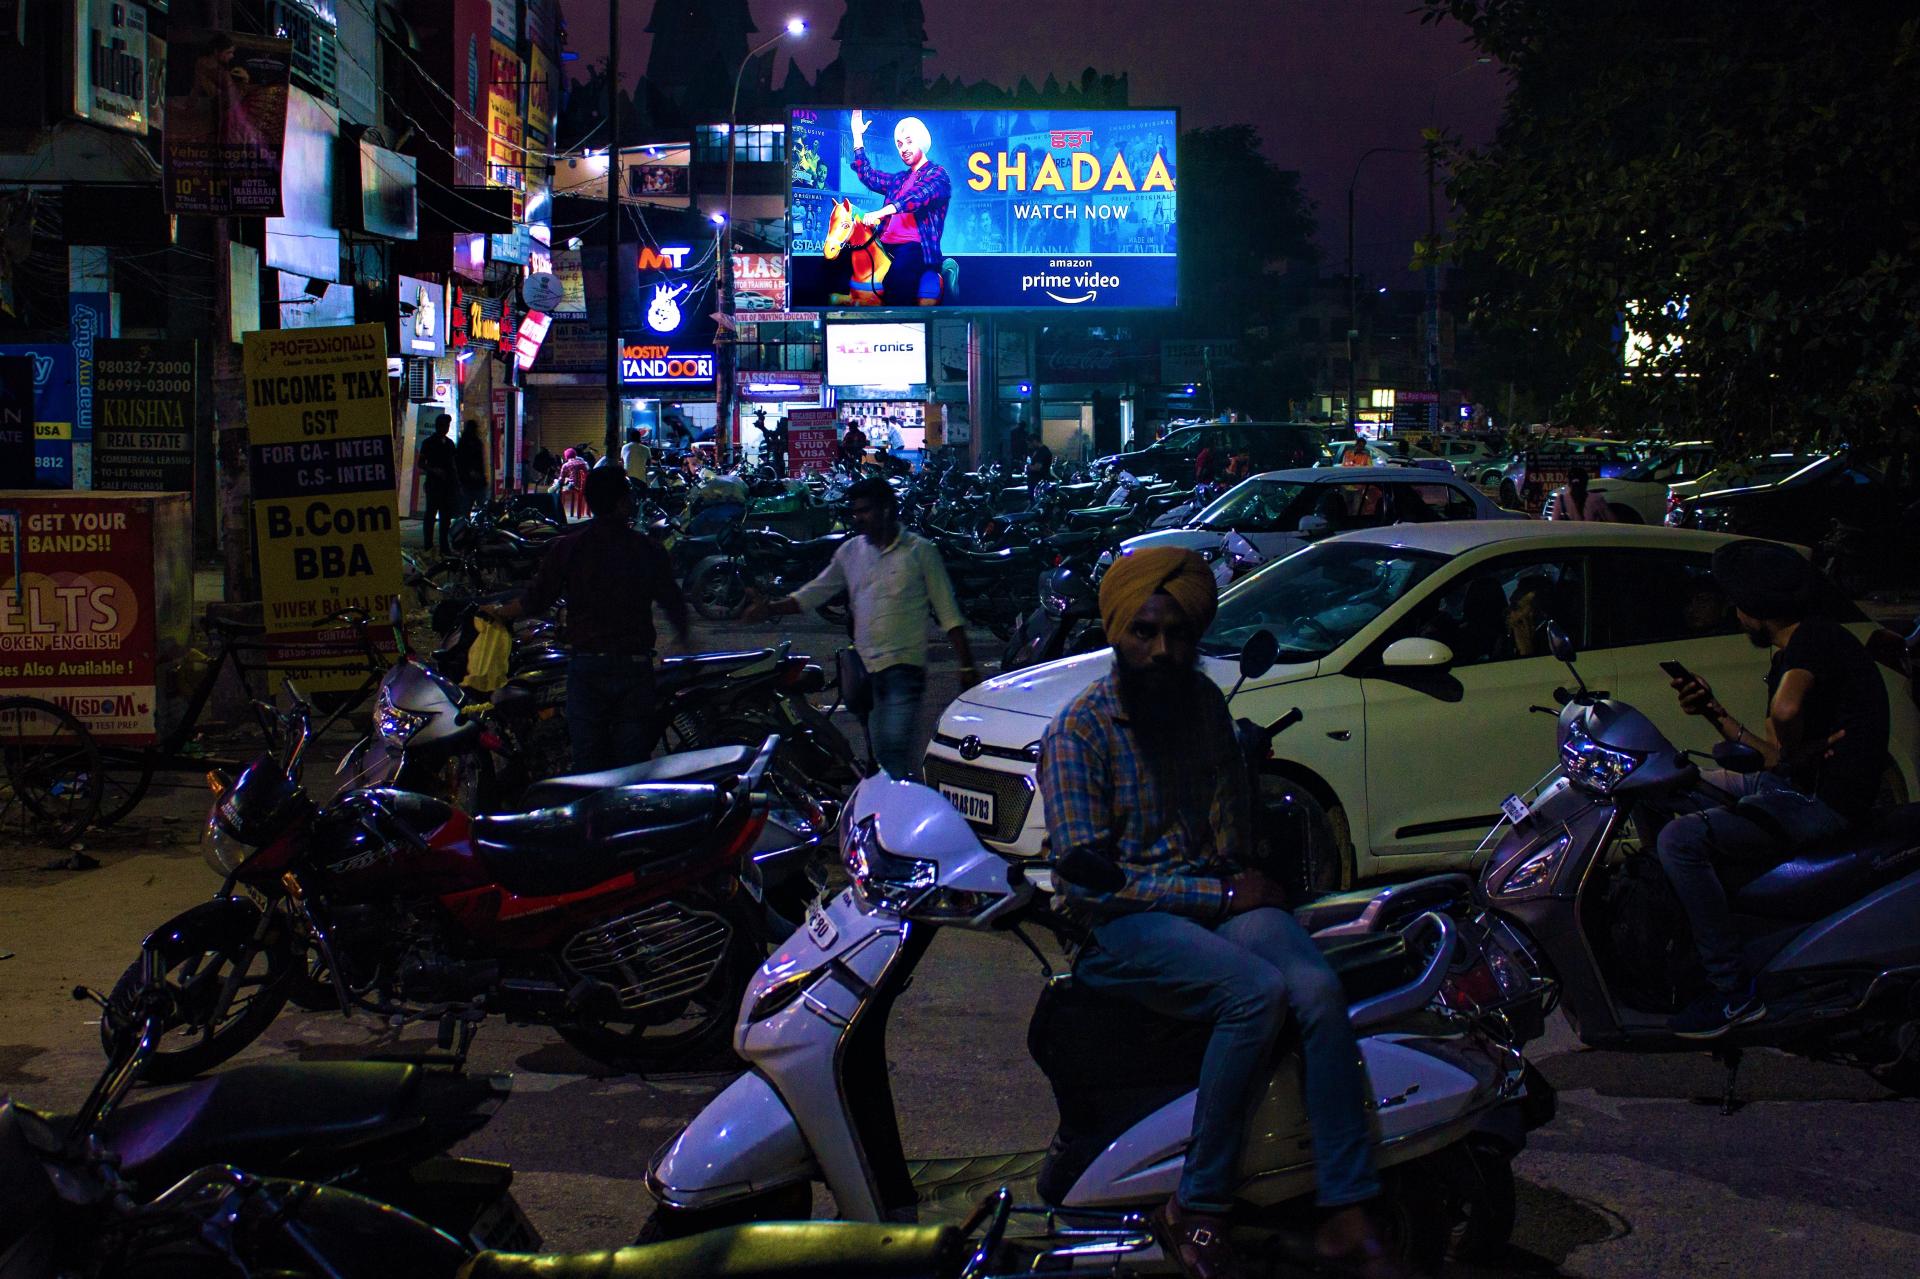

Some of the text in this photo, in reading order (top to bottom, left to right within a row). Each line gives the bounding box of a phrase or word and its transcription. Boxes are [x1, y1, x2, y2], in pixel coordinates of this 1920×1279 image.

[967, 152, 1175, 191] SHADAA
[241, 179, 267, 187] HOTEL
[233, 187, 277, 196] MAHARAJA
[236, 196, 275, 205] REGENCY
[1014, 204, 1129, 219] WATCH NOW
[638, 247, 691, 269] MT
[1049, 259, 1093, 268] amazon
[732, 256, 783, 278] CLAS
[1022, 272, 1120, 291] prime video
[758, 313, 782, 321] DRIVING
[784, 312, 818, 320] EDUCATION
[270, 334, 375, 356] PROFESSIONALS
[623, 346, 669, 359] MOSTLY
[72, 304, 97, 428] mapmystudy
[98, 361, 191, 374] 98032-73000
[623, 359, 712, 377] TANDOORI
[736, 373, 776, 382] LASSIC
[97, 379, 191, 393] 86999-03000
[253, 369, 384, 407] INCOME TAX
[103, 399, 185, 428] KRISHNA
[302, 409, 338, 435] GST
[36, 426, 61, 436] USA
[799, 432, 825, 440] IELTS
[107, 434, 181, 449] REAL ESTATE
[794, 440, 831, 449] STUDY
[262, 439, 384, 465] FOR CA- INTER
[799, 450, 826, 458] VISA
[102, 456, 192, 465] COMMERCIAL LEASING
[101, 468, 128, 478] TO-LET
[298, 463, 386, 487] C.S- INTER
[122, 481, 166, 490] PURCHASE
[28, 512, 127, 532] GET YOUR
[267, 502, 391, 539] B.Com
[28, 534, 112, 553] BANDS!!
[294, 543, 374, 580] BBA
[272, 600, 318, 619] VIVEK
[52, 633, 120, 650] ENGLISH
[23, 662, 54, 677] Also
[58, 661, 125, 677] Available
[53, 695, 136, 717] WISDOM
[117, 721, 138, 729] PREP
[970, 797, 989, 819] 0783
